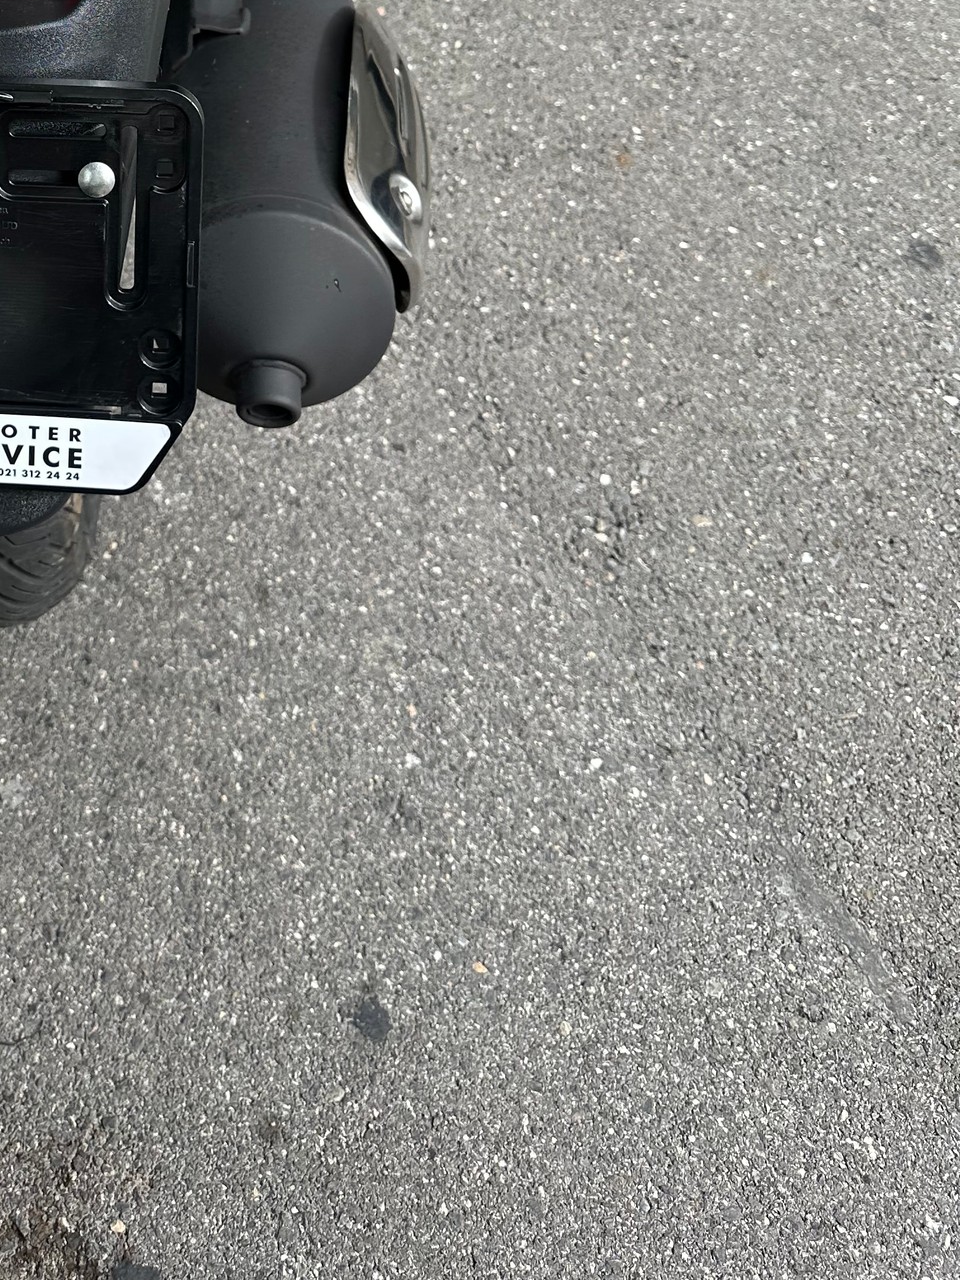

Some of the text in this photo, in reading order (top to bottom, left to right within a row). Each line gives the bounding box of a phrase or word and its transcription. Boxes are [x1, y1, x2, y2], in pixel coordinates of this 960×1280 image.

[22, 469, 41, 479] 312
[46, 471, 60, 480] 24
[65, 472, 80, 481] 24
